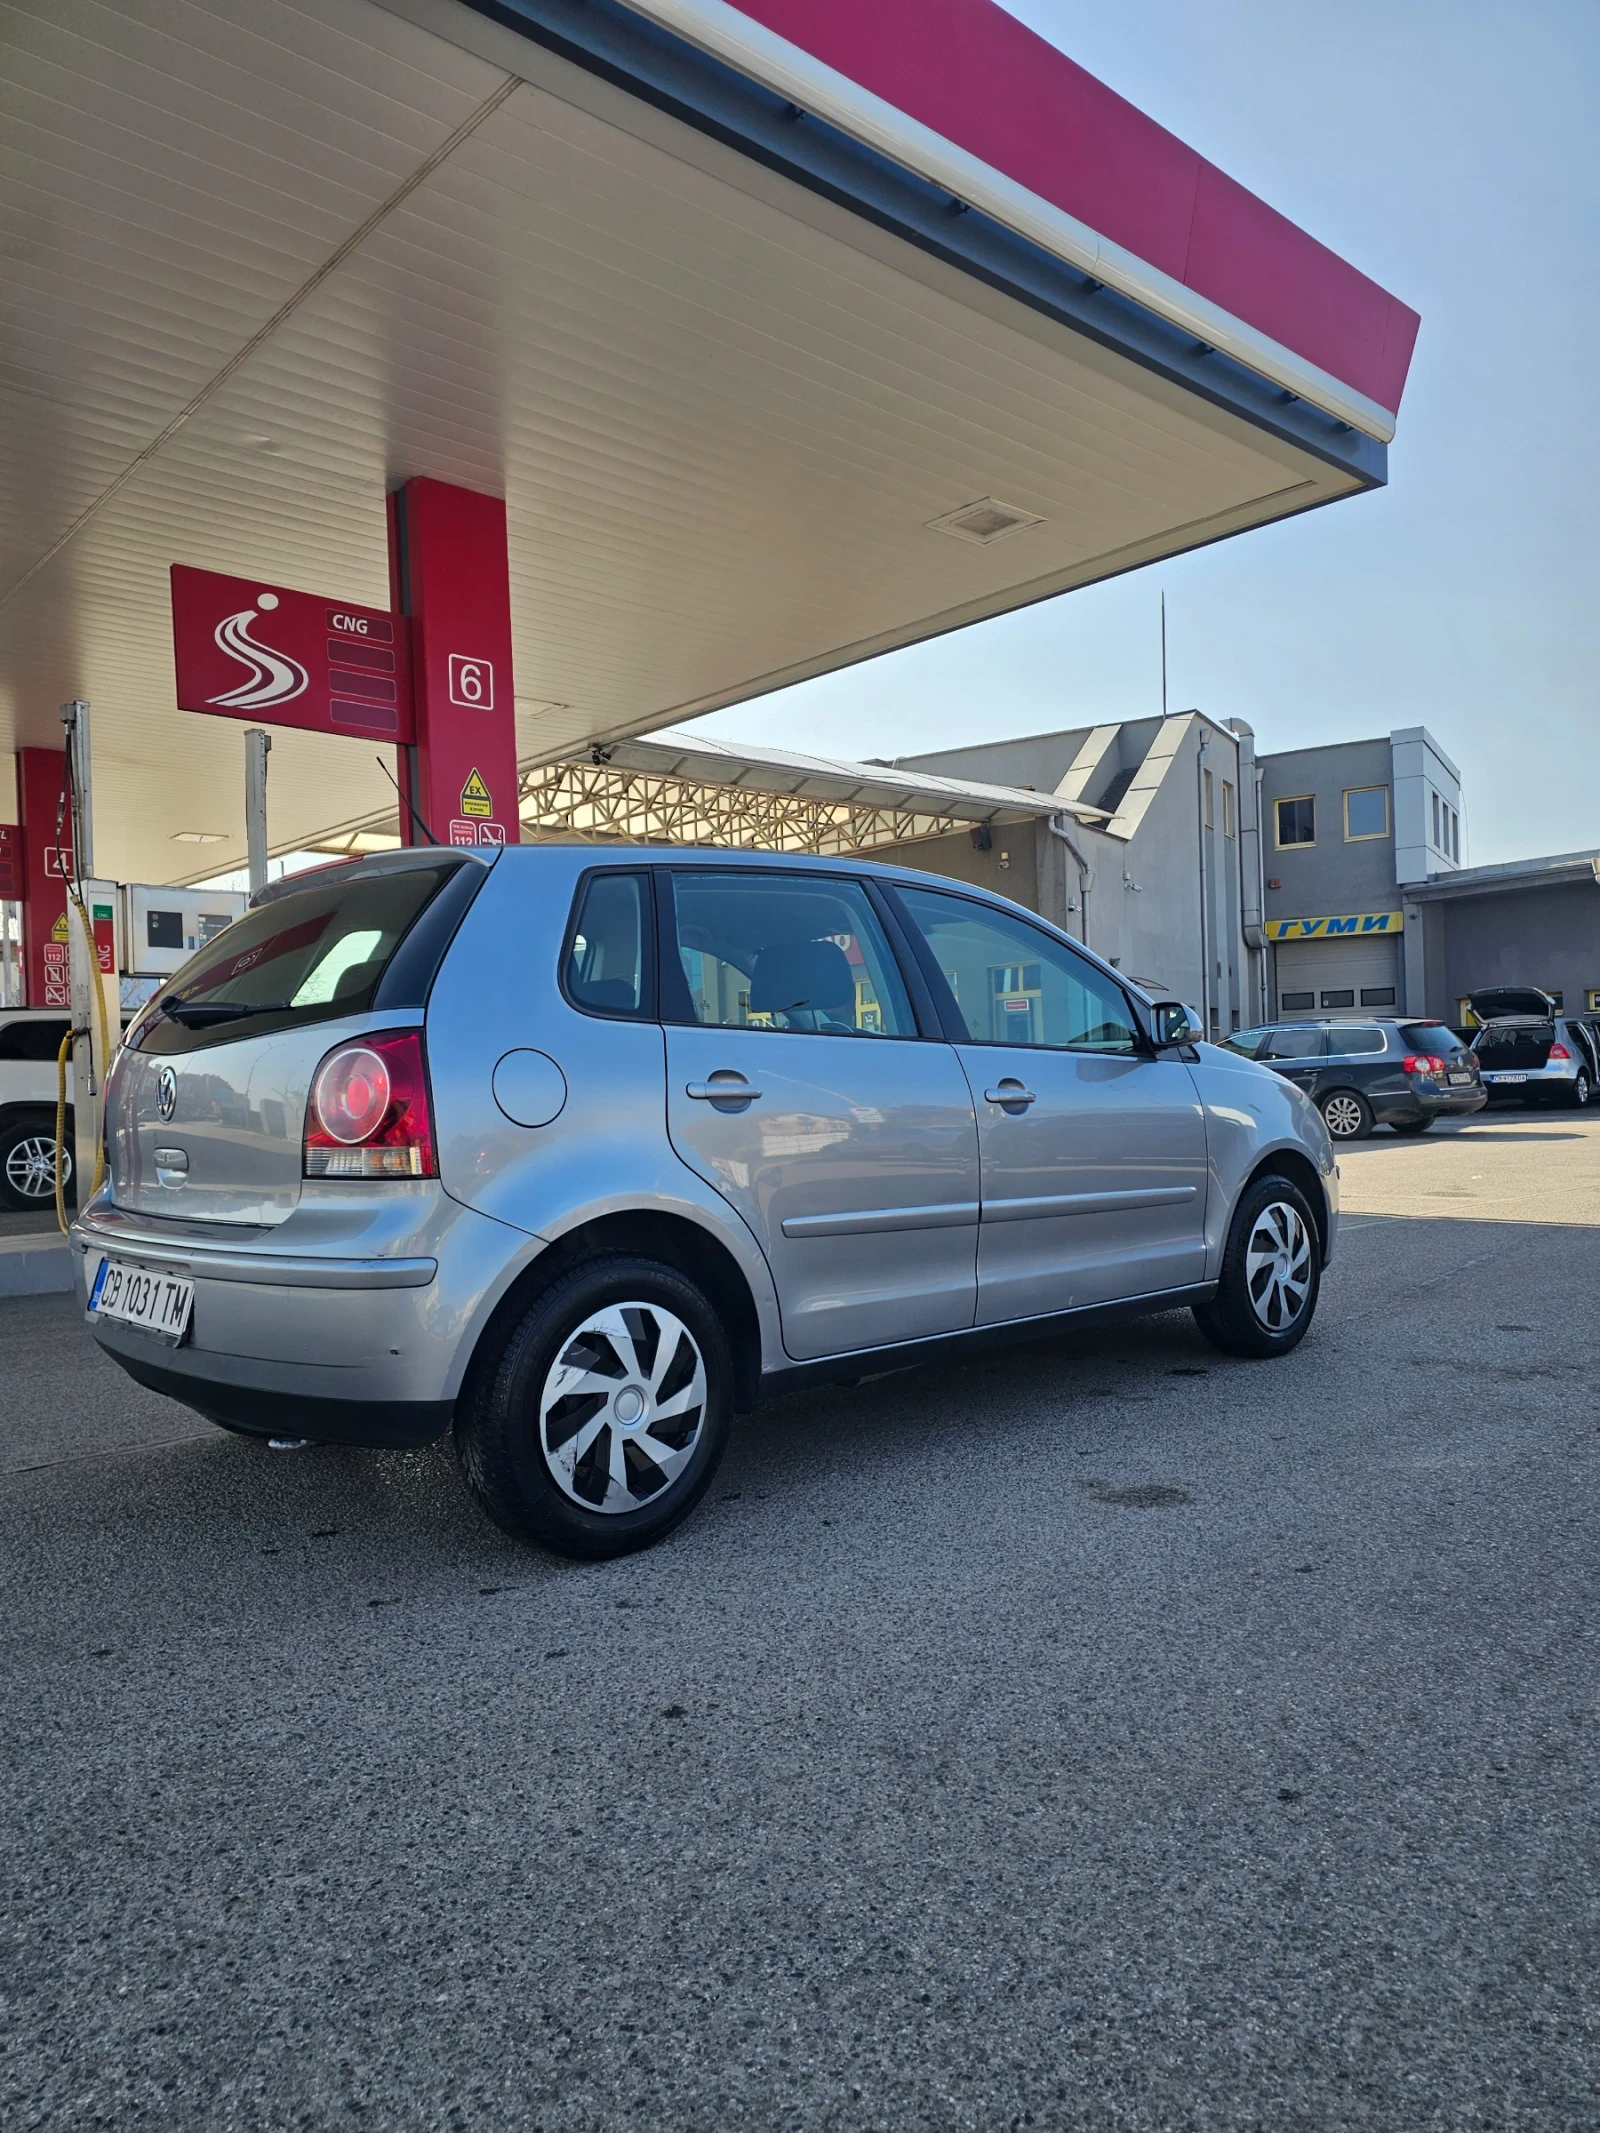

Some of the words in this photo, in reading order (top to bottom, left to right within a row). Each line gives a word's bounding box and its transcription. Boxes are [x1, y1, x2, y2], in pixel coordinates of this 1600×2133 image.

[332, 614, 368, 634] CNG
[460, 664, 482, 700] 6
[469, 785, 482, 795] EX
[455, 836, 473, 845] 112
[52, 852, 70, 874] 4
[1277, 914, 1390, 937] ГУМИ
[47, 953, 62, 961] 112
[97, 945, 111, 969] CNG
[101, 1269, 123, 1308] CB
[121, 1274, 161, 1320] 1031
[162, 1282, 189, 1328] TM
